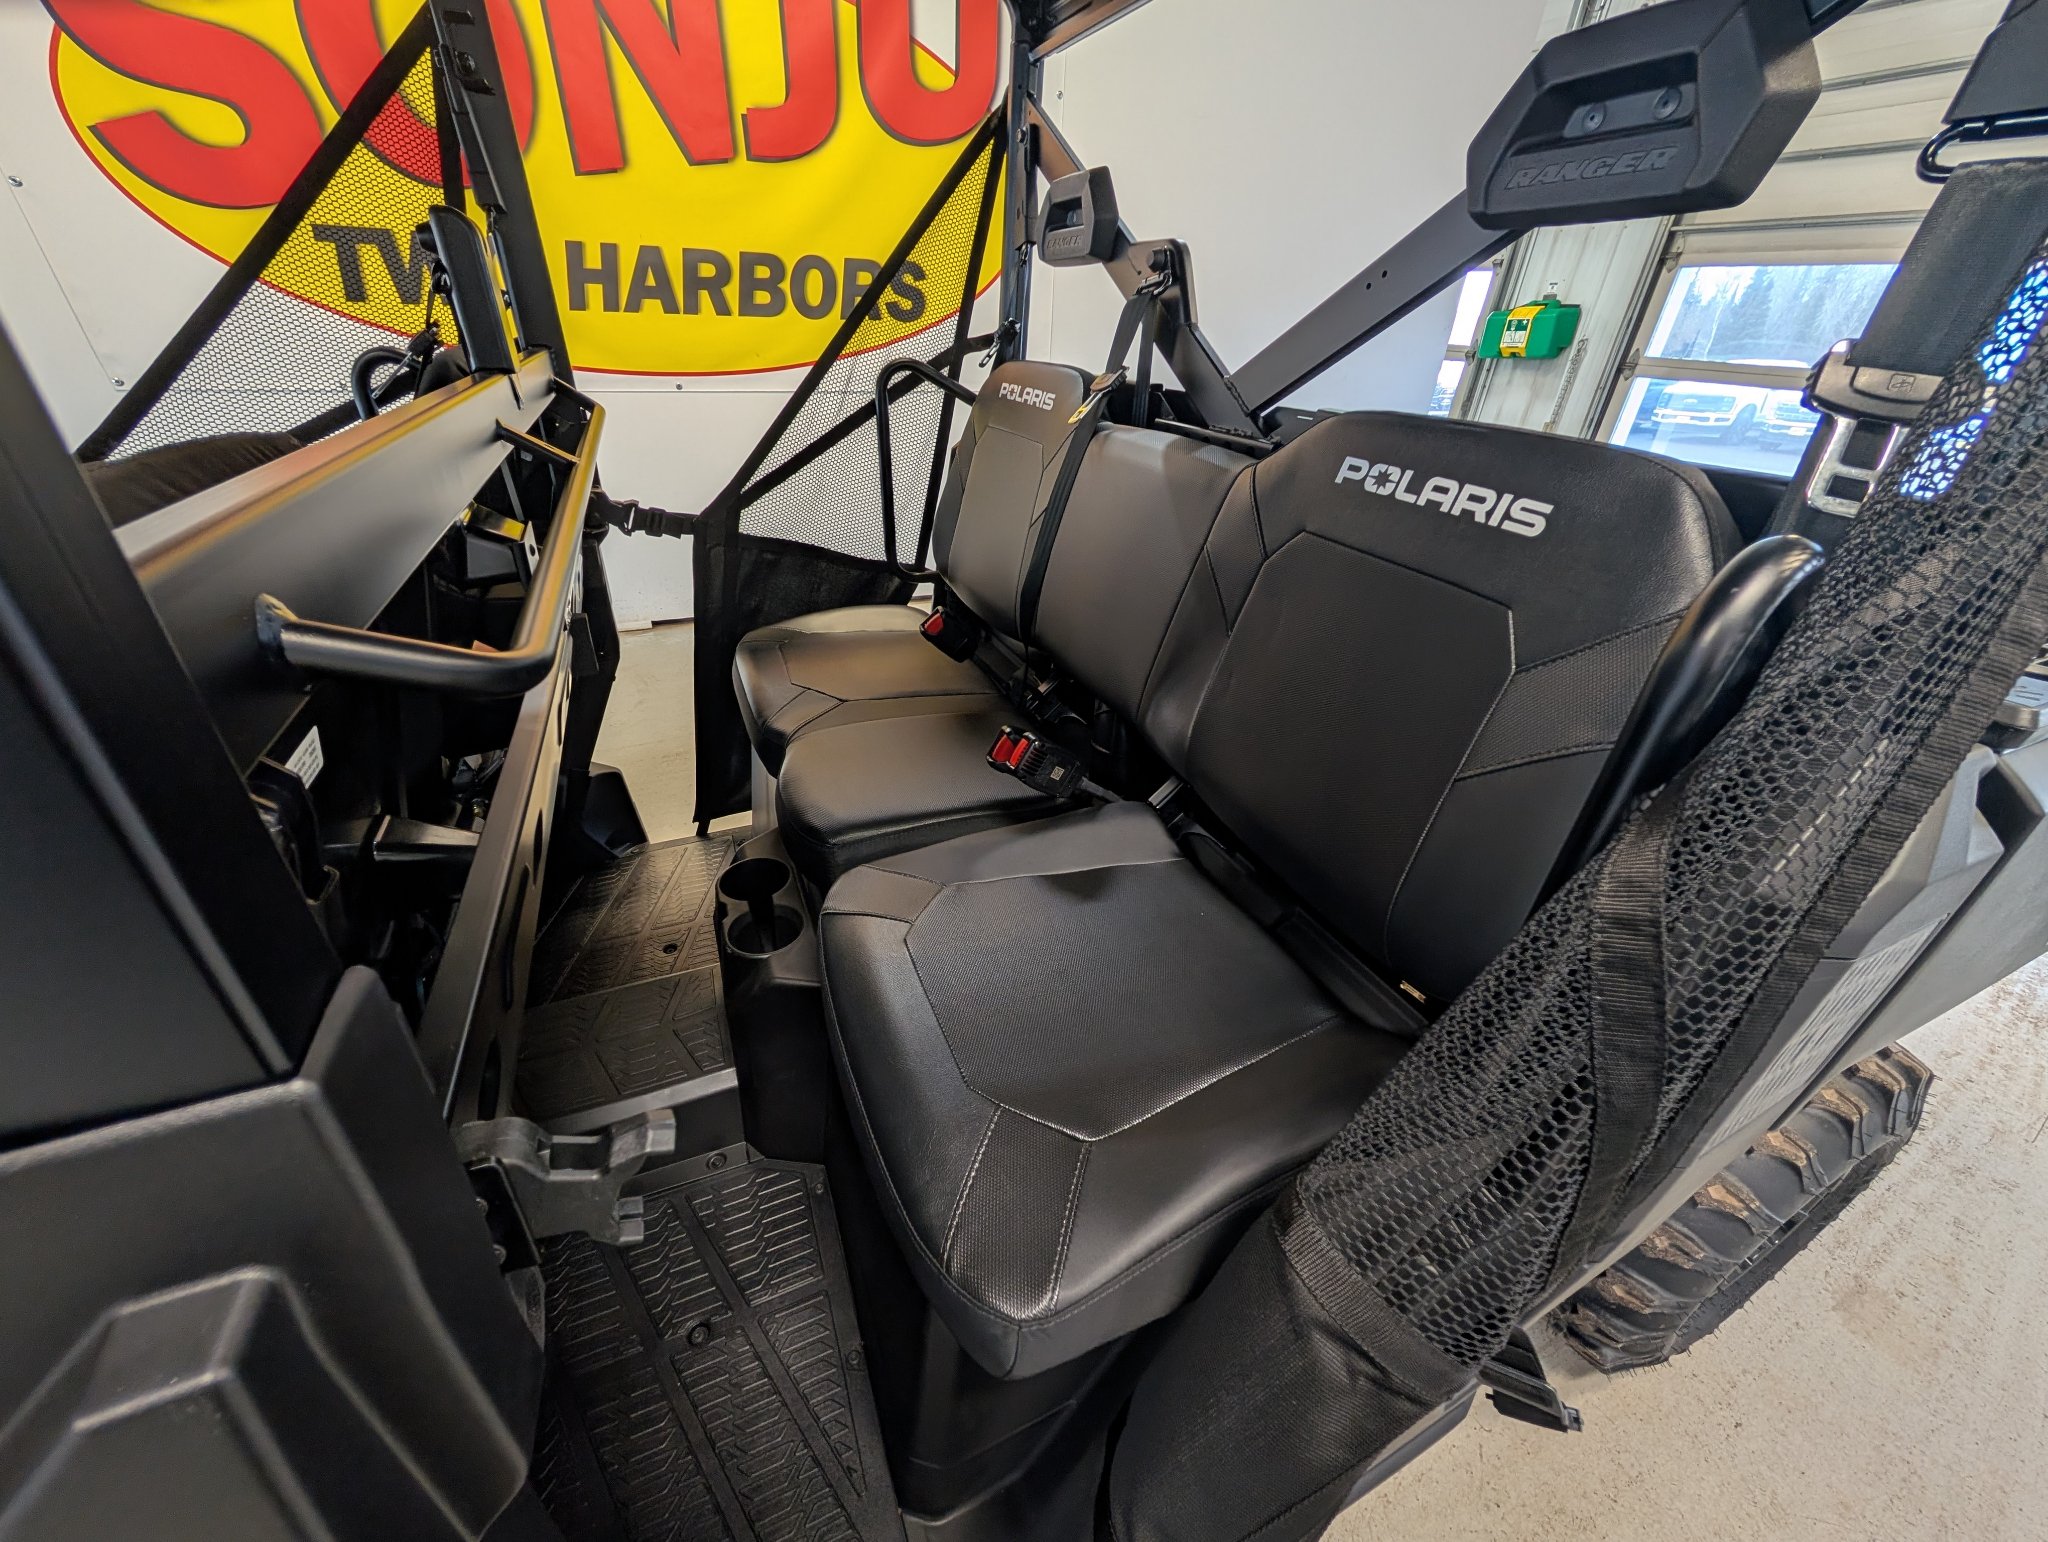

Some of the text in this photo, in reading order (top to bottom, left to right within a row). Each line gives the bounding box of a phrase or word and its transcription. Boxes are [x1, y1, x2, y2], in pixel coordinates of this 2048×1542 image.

[1504, 145, 1678, 190] RANGER
[312, 224, 928, 323] TW HARBORS
[998, 382, 1057, 411] POLARIS
[1334, 455, 1555, 538] POLARIS
